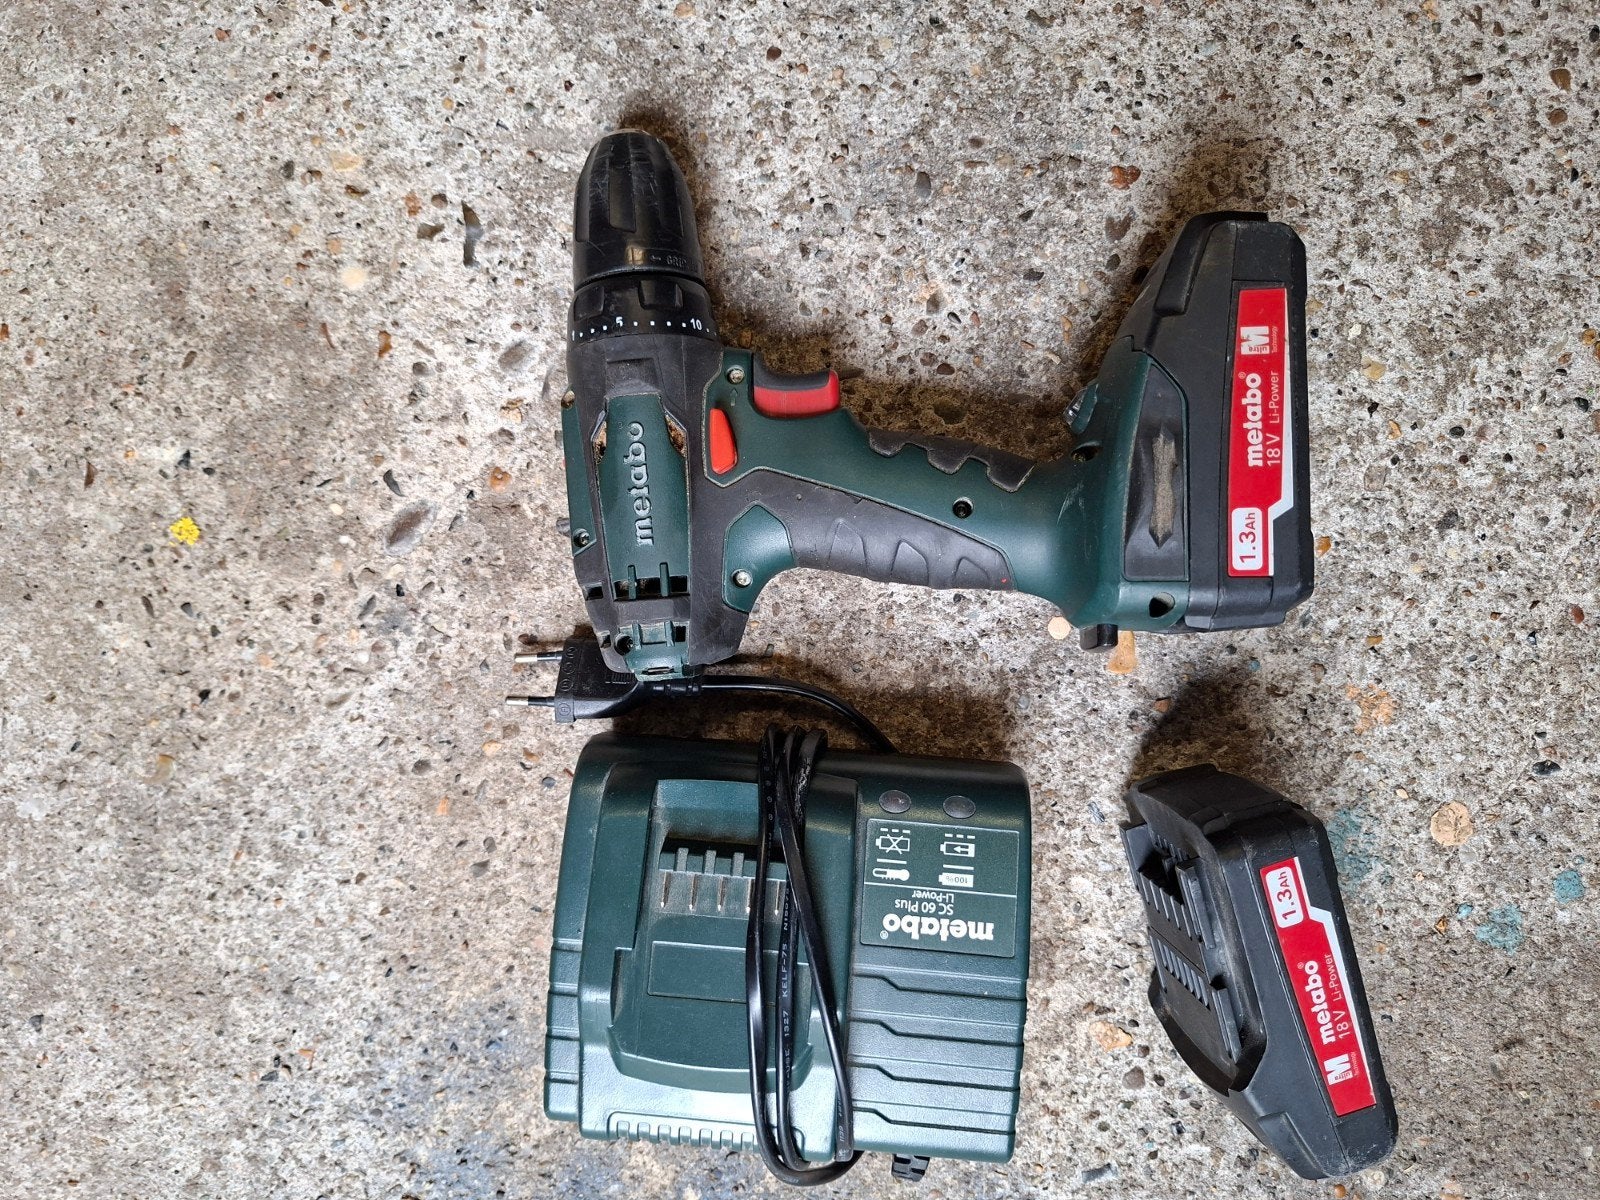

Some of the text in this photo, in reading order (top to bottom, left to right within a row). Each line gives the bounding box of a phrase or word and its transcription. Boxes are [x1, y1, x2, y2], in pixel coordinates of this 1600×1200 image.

[615, 316, 623, 327] 5
[690, 318, 702, 330] 10
[1265, 370, 1281, 467] 18 V Li-Power
[1239, 512, 1256, 563] 1.3Ah
[895, 899, 954, 915] SC 60 Plus
[1277, 871, 1297, 920] 1.3Ah
[1324, 953, 1351, 1039] 18 V Li-Power
